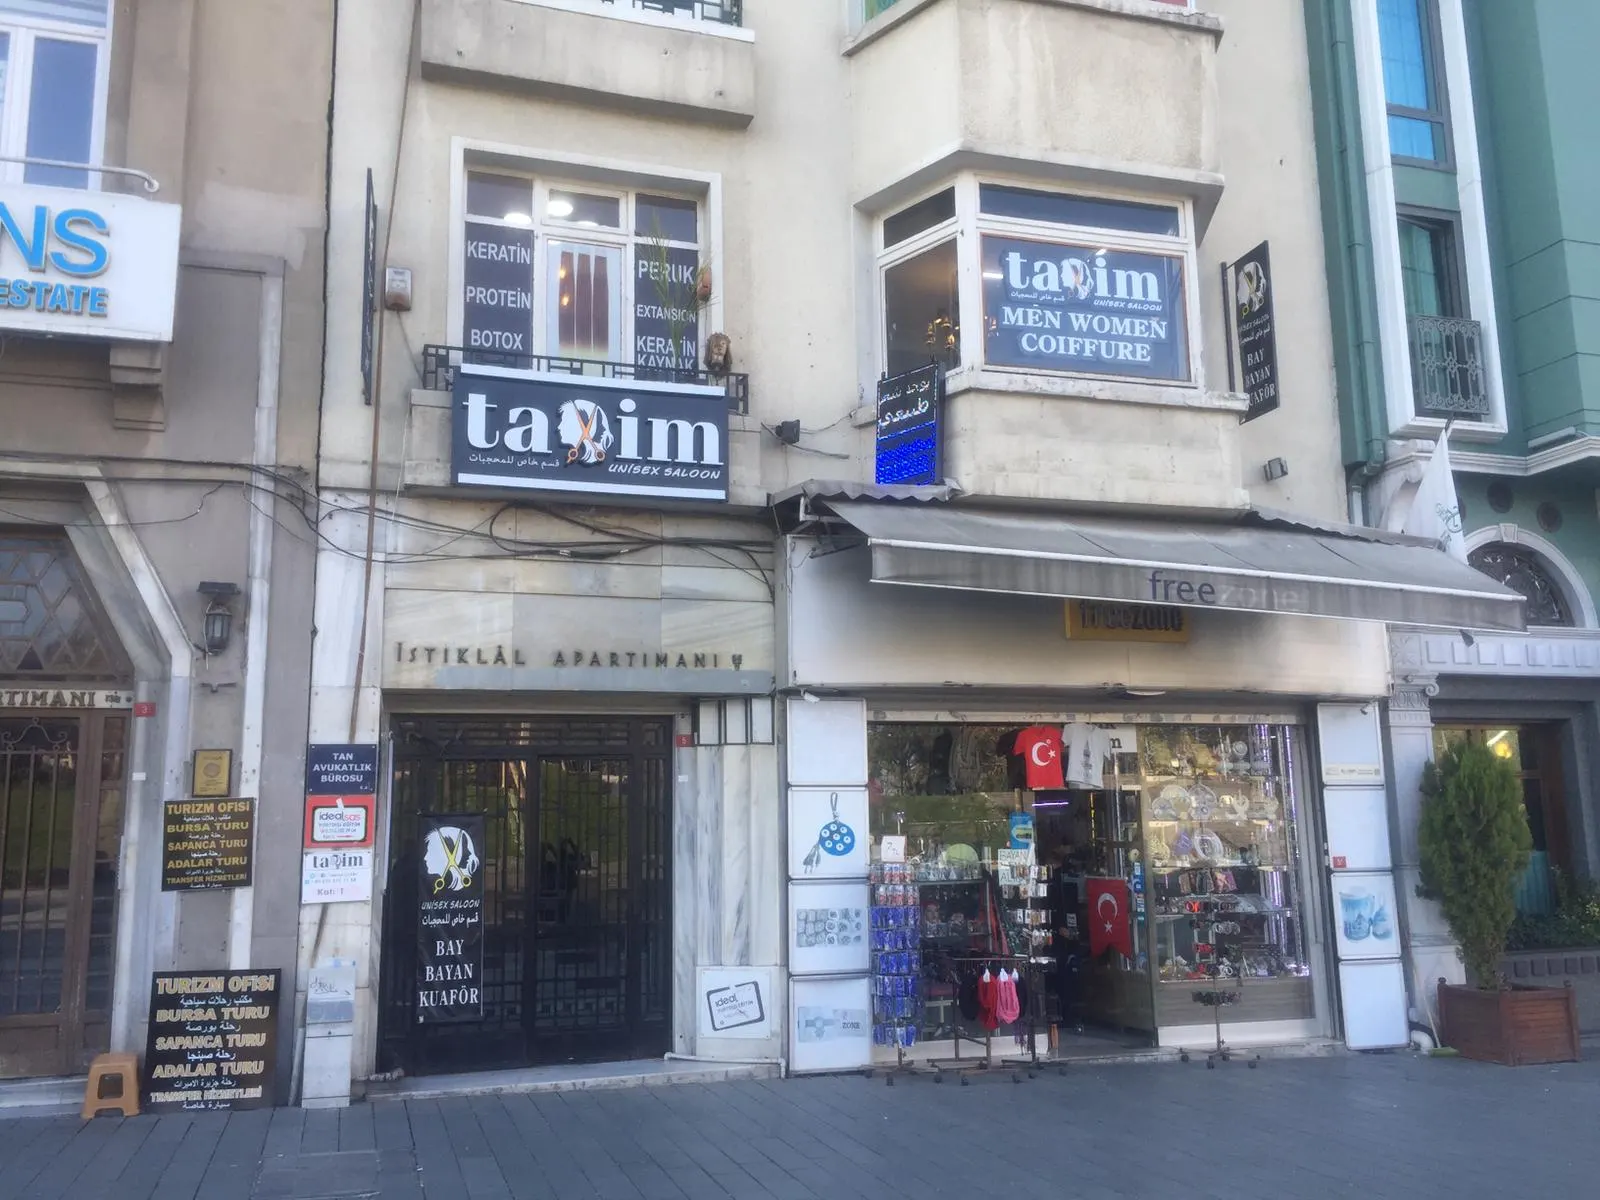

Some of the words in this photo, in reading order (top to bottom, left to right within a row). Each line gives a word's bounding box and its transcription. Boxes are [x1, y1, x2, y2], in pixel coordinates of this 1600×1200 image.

[466, 240, 531, 266] KERATİN
[465, 285, 531, 310] PROTEİN
[1068, 312, 1168, 342] WOMEN
[470, 329, 524, 352] BOTOX
[637, 335, 696, 357] KERAİN
[1020, 332, 1152, 365] COIFFURE
[1247, 348, 1264, 367] BAY
[1249, 384, 1276, 406] UAFÖR
[664, 467, 721, 480] SALOON
[552, 650, 719, 669] APARTIMANI
[332, 752, 354, 761] TAN
[312, 763, 372, 772] AVUKATLIK
[320, 773, 364, 783] BÜROSU
[167, 823, 210, 834] BURSA
[214, 821, 249, 832] TURU
[168, 841, 216, 851] SAPANCA
[219, 839, 248, 849] TURU
[167, 858, 213, 869] ADALAR
[216, 856, 248, 867] TURU
[167, 876, 204, 884] TRANSFER
[450, 898, 480, 909] SALOON
[435, 939, 465, 956] BAY
[425, 963, 474, 982] BAYAN
[419, 985, 480, 1008] KUAFÖR
[156, 1008, 217, 1022] BURSA
[221, 1006, 270, 1020] TURU
[155, 1035, 223, 1050] SAPANCA
[226, 1033, 266, 1048] TURU
[216, 1049, 236, 1060] رحلة
[152, 1062, 217, 1079] ADALAR
[220, 1060, 265, 1075] TURU
